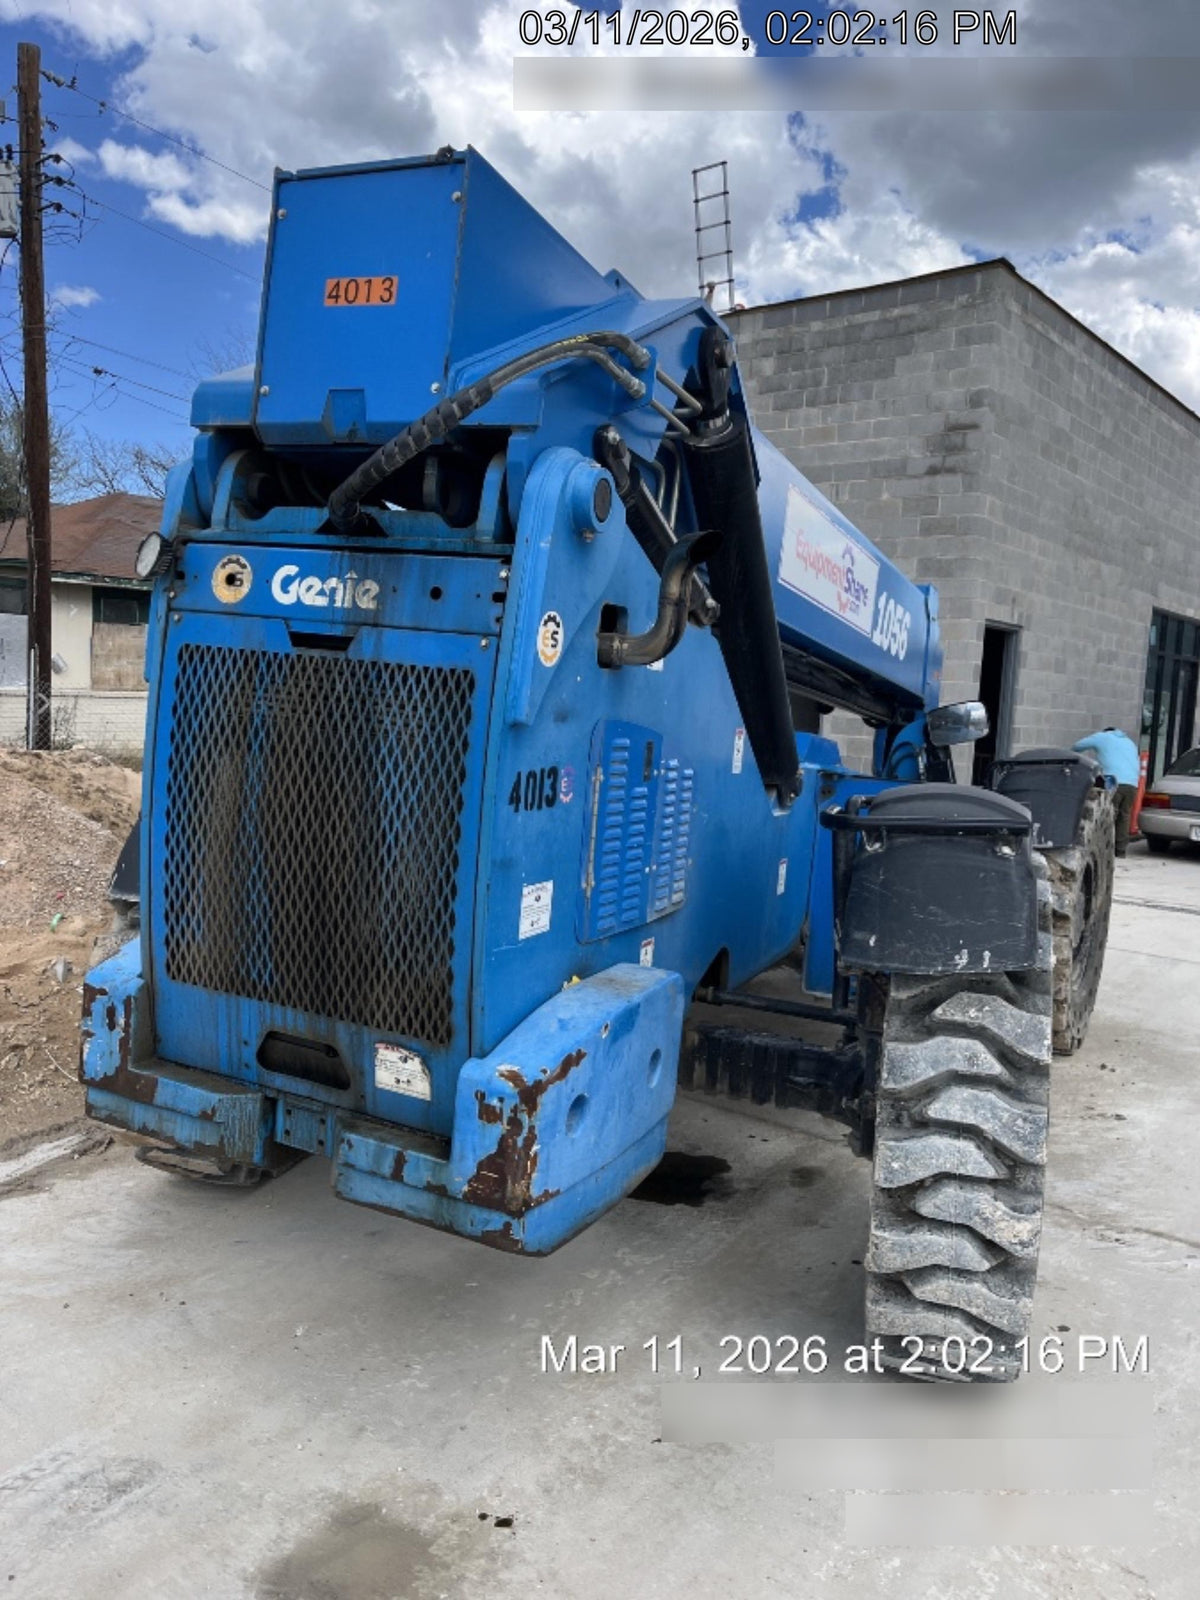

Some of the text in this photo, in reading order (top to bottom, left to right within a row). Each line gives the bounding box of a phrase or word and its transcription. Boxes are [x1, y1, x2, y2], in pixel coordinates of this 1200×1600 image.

[326, 276, 395, 304] 4013
[271, 564, 380, 610] Genie
[542, 629, 559, 649] ES
[871, 591, 911, 661] 1056
[508, 765, 559, 813] 4013
